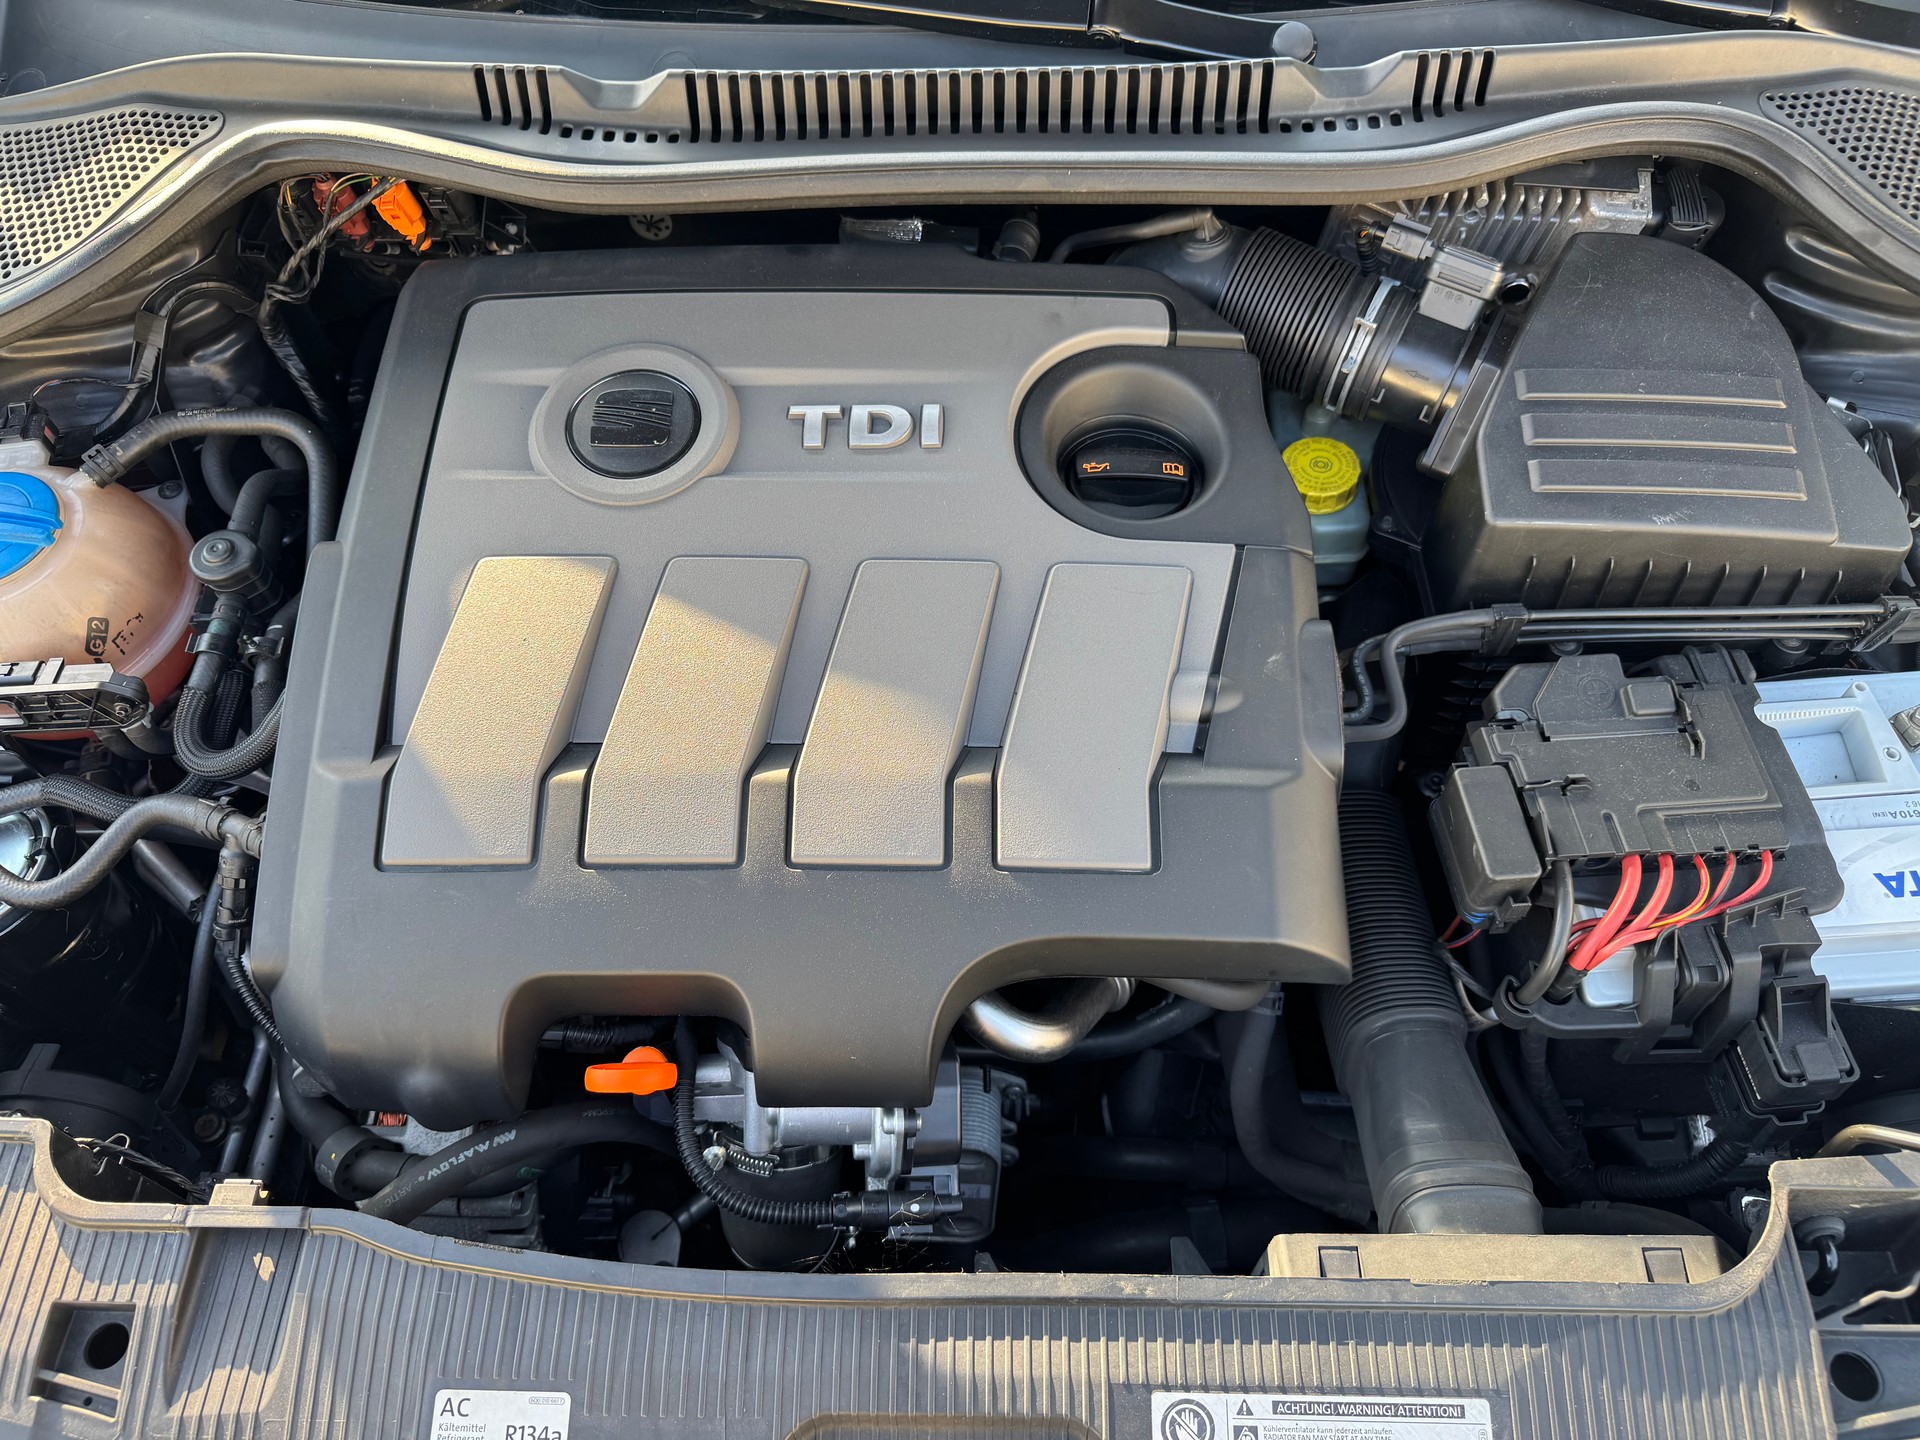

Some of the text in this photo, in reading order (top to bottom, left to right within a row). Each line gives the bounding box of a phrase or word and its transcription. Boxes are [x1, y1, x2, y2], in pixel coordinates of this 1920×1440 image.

[787, 403, 945, 450] TDI
[439, 1397, 471, 1417] AC
[1276, 1402, 1462, 1418] ACHTUNG! WARNING! ATTENTION!
[438, 1422, 486, 1433] Kältemittel
[505, 1425, 562, 1440] R134a
[1263, 1425, 1315, 1434] Kühlerventilator
[1316, 1426, 1333, 1434] kann
[1334, 1427, 1362, 1436] jederzeit
